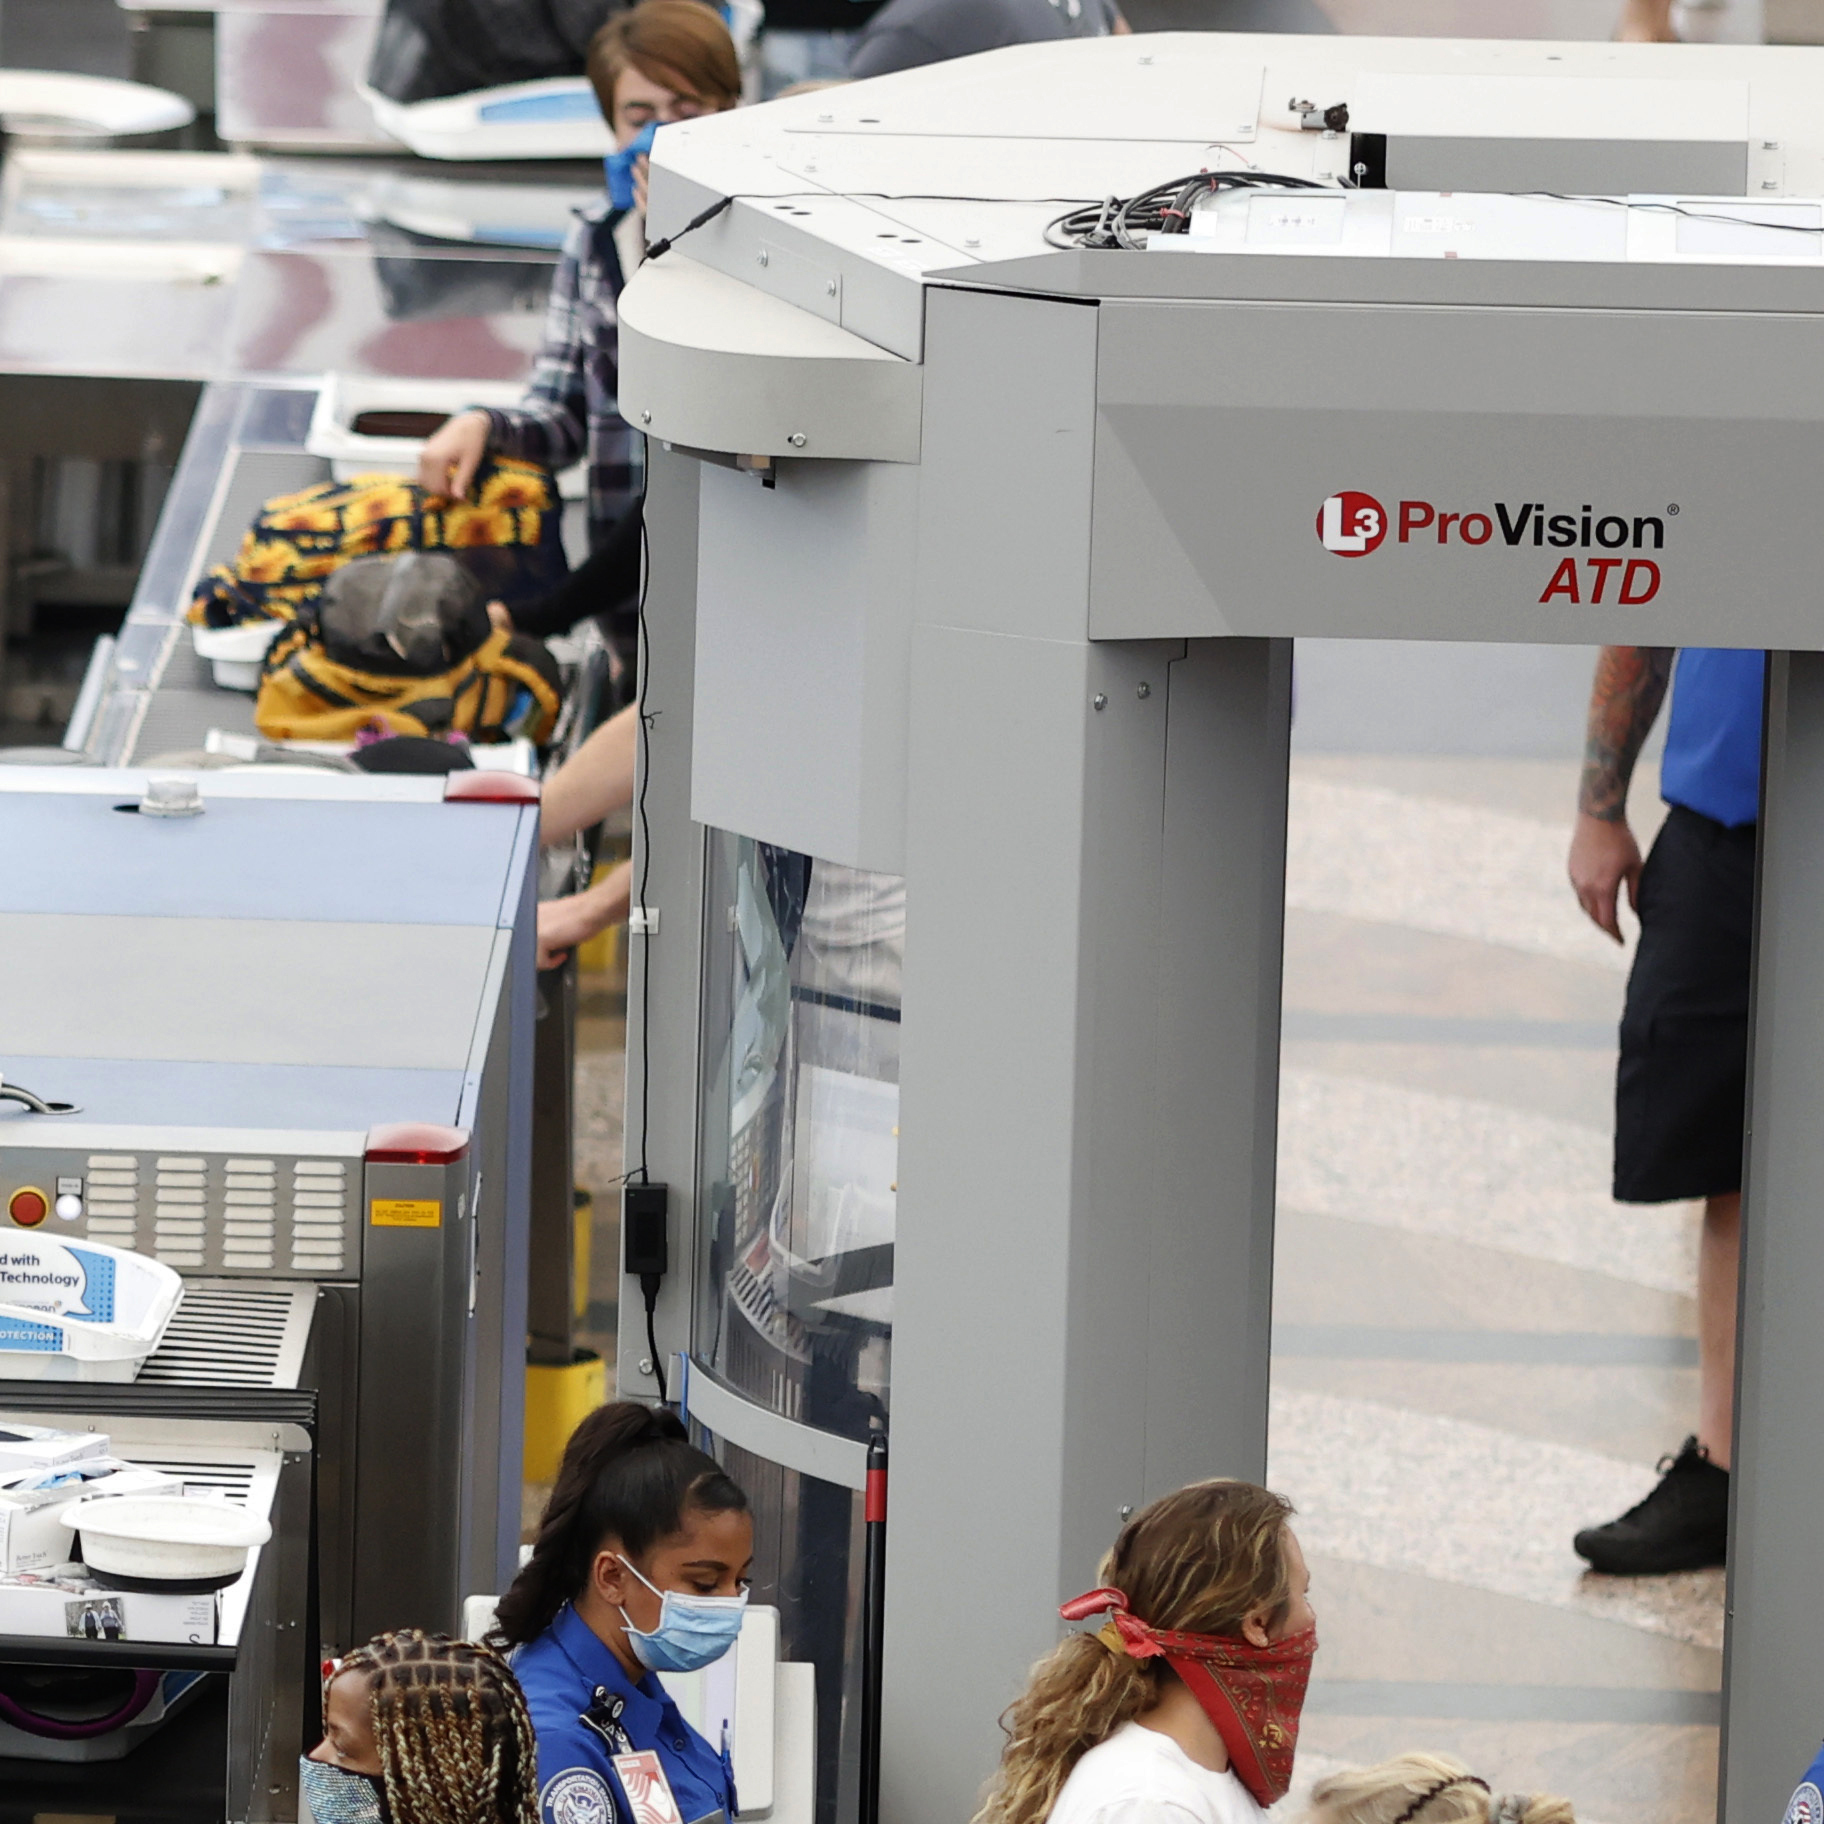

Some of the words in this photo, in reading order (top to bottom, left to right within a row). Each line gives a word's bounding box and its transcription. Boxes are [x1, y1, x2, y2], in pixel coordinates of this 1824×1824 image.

[1538, 557, 1661, 605] ATD
[12, 1253, 40, 1267] with
[545, 1774, 601, 1808] TRANSPORTATION
